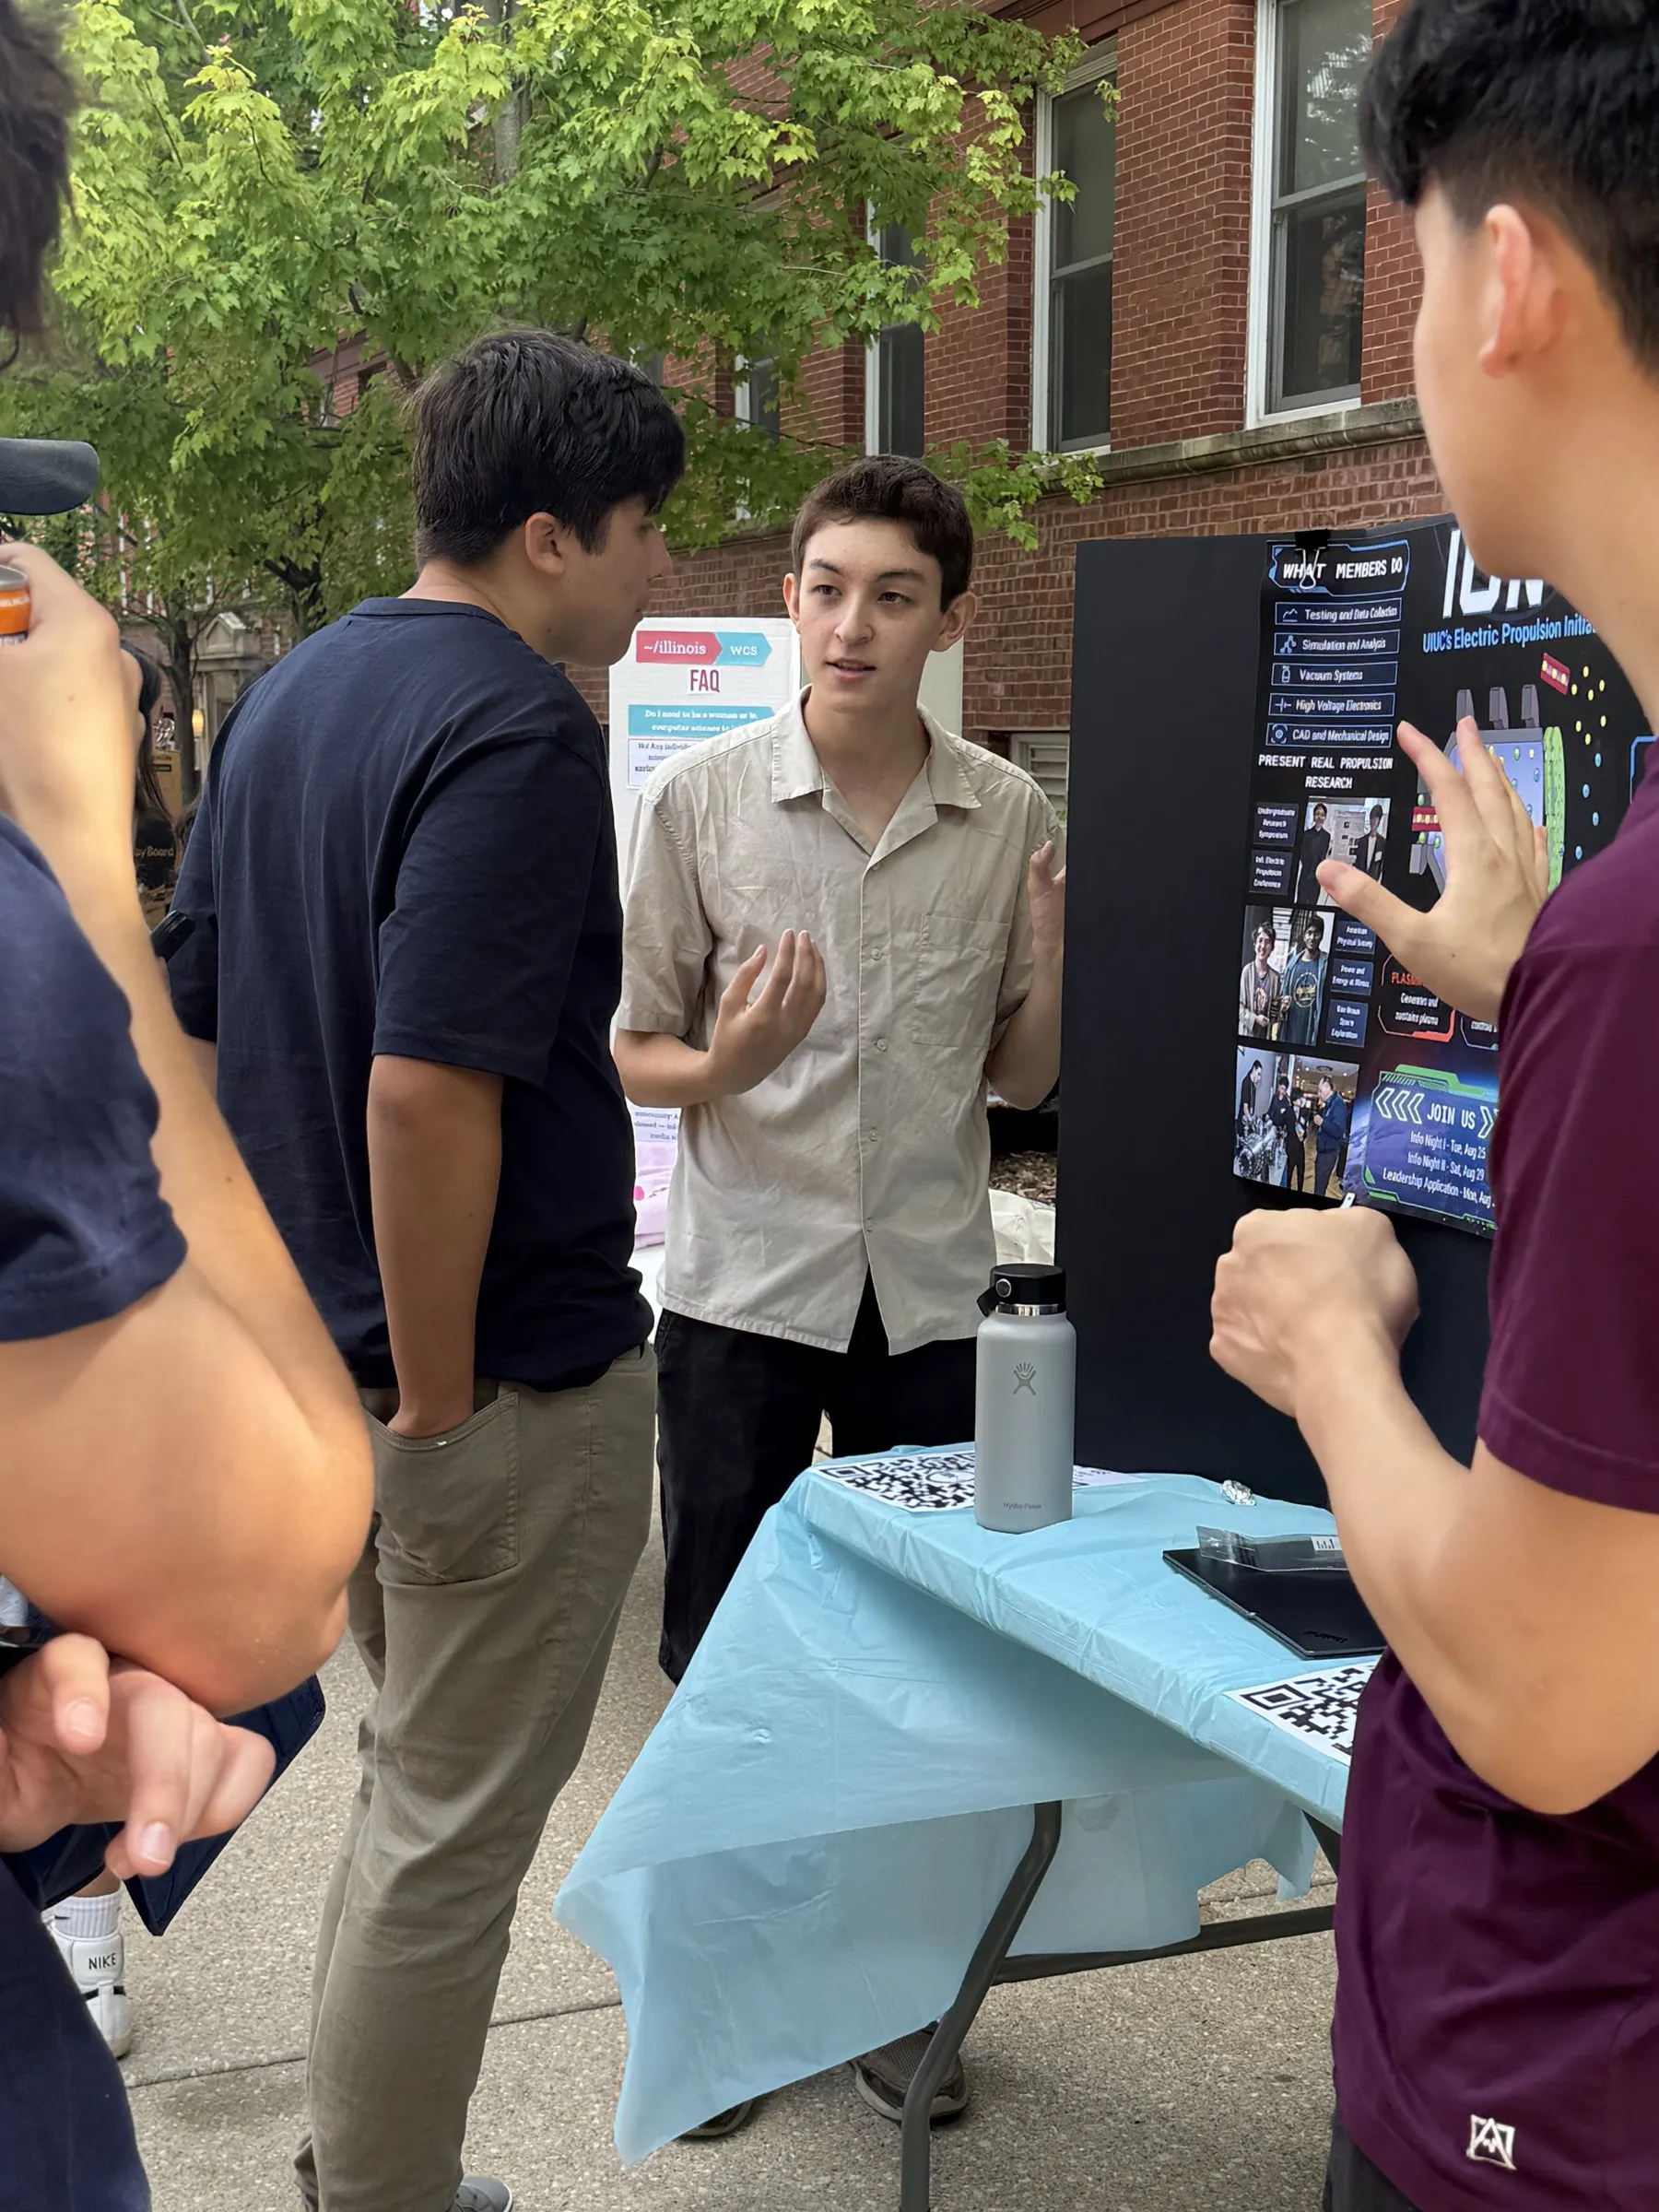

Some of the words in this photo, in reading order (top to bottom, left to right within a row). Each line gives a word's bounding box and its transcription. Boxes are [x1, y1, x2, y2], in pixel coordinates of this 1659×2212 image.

[1282, 563, 1327, 580] WHAT
[1335, 559, 1387, 579] MEMBERS
[1391, 556, 1403, 574] DO
[1304, 608, 1337, 624] Testing
[1338, 608, 1354, 621] and
[1354, 607, 1370, 620] Data
[1370, 606, 1398, 618] Collection
[1302, 639, 1346, 651] Simulation
[1347, 639, 1360, 651] and
[1360, 638, 1386, 652] Analysis
[1422, 629, 1453, 653] UIUC's
[1453, 624, 1499, 650] Electric
[1501, 618, 1561, 648] Propulsion
[689, 669, 721, 693] FAQ
[1299, 668, 1333, 681] Vacuum
[1334, 669, 1363, 683] Systems
[1296, 699, 1315, 714] High
[1317, 700, 1345, 713] Voltage
[1346, 699, 1382, 712] Electronics
[1292, 729, 1311, 740] CAD
[1312, 730, 1326, 741] and
[1327, 729, 1367, 742] Mechanical
[1368, 730, 1389, 744] Design
[1258, 754, 1306, 768] PRESENT
[1311, 757, 1335, 769] REAL
[1339, 757, 1394, 770] PROPULSION
[1305, 775, 1353, 789] RESEARCH
[1427, 1102, 1456, 1125] JOIN
[1461, 1109, 1476, 1130] US
[1410, 1131, 1424, 1146] Info
[1425, 1133, 1443, 1151] Night
[1451, 1139, 1464, 1156] Tue,
[1464, 1143, 1477, 1160] Aug
[1477, 1146, 1487, 1159] 25
[1407, 1150, 1422, 1165] Info
[1422, 1153, 1441, 1171] Night
[1450, 1160, 1462, 1178] Sat,
[1463, 1165, 1476, 1182] Aug
[1476, 1168, 1485, 1182] 29
[1382, 1167, 1423, 1191] Leadership
[1423, 1176, 1459, 1196] Application
[1463, 1186, 1478, 1204] Mon,
[1478, 1190, 1491, 1209] Aug
[88, 1952, 116, 1971] NIKE
